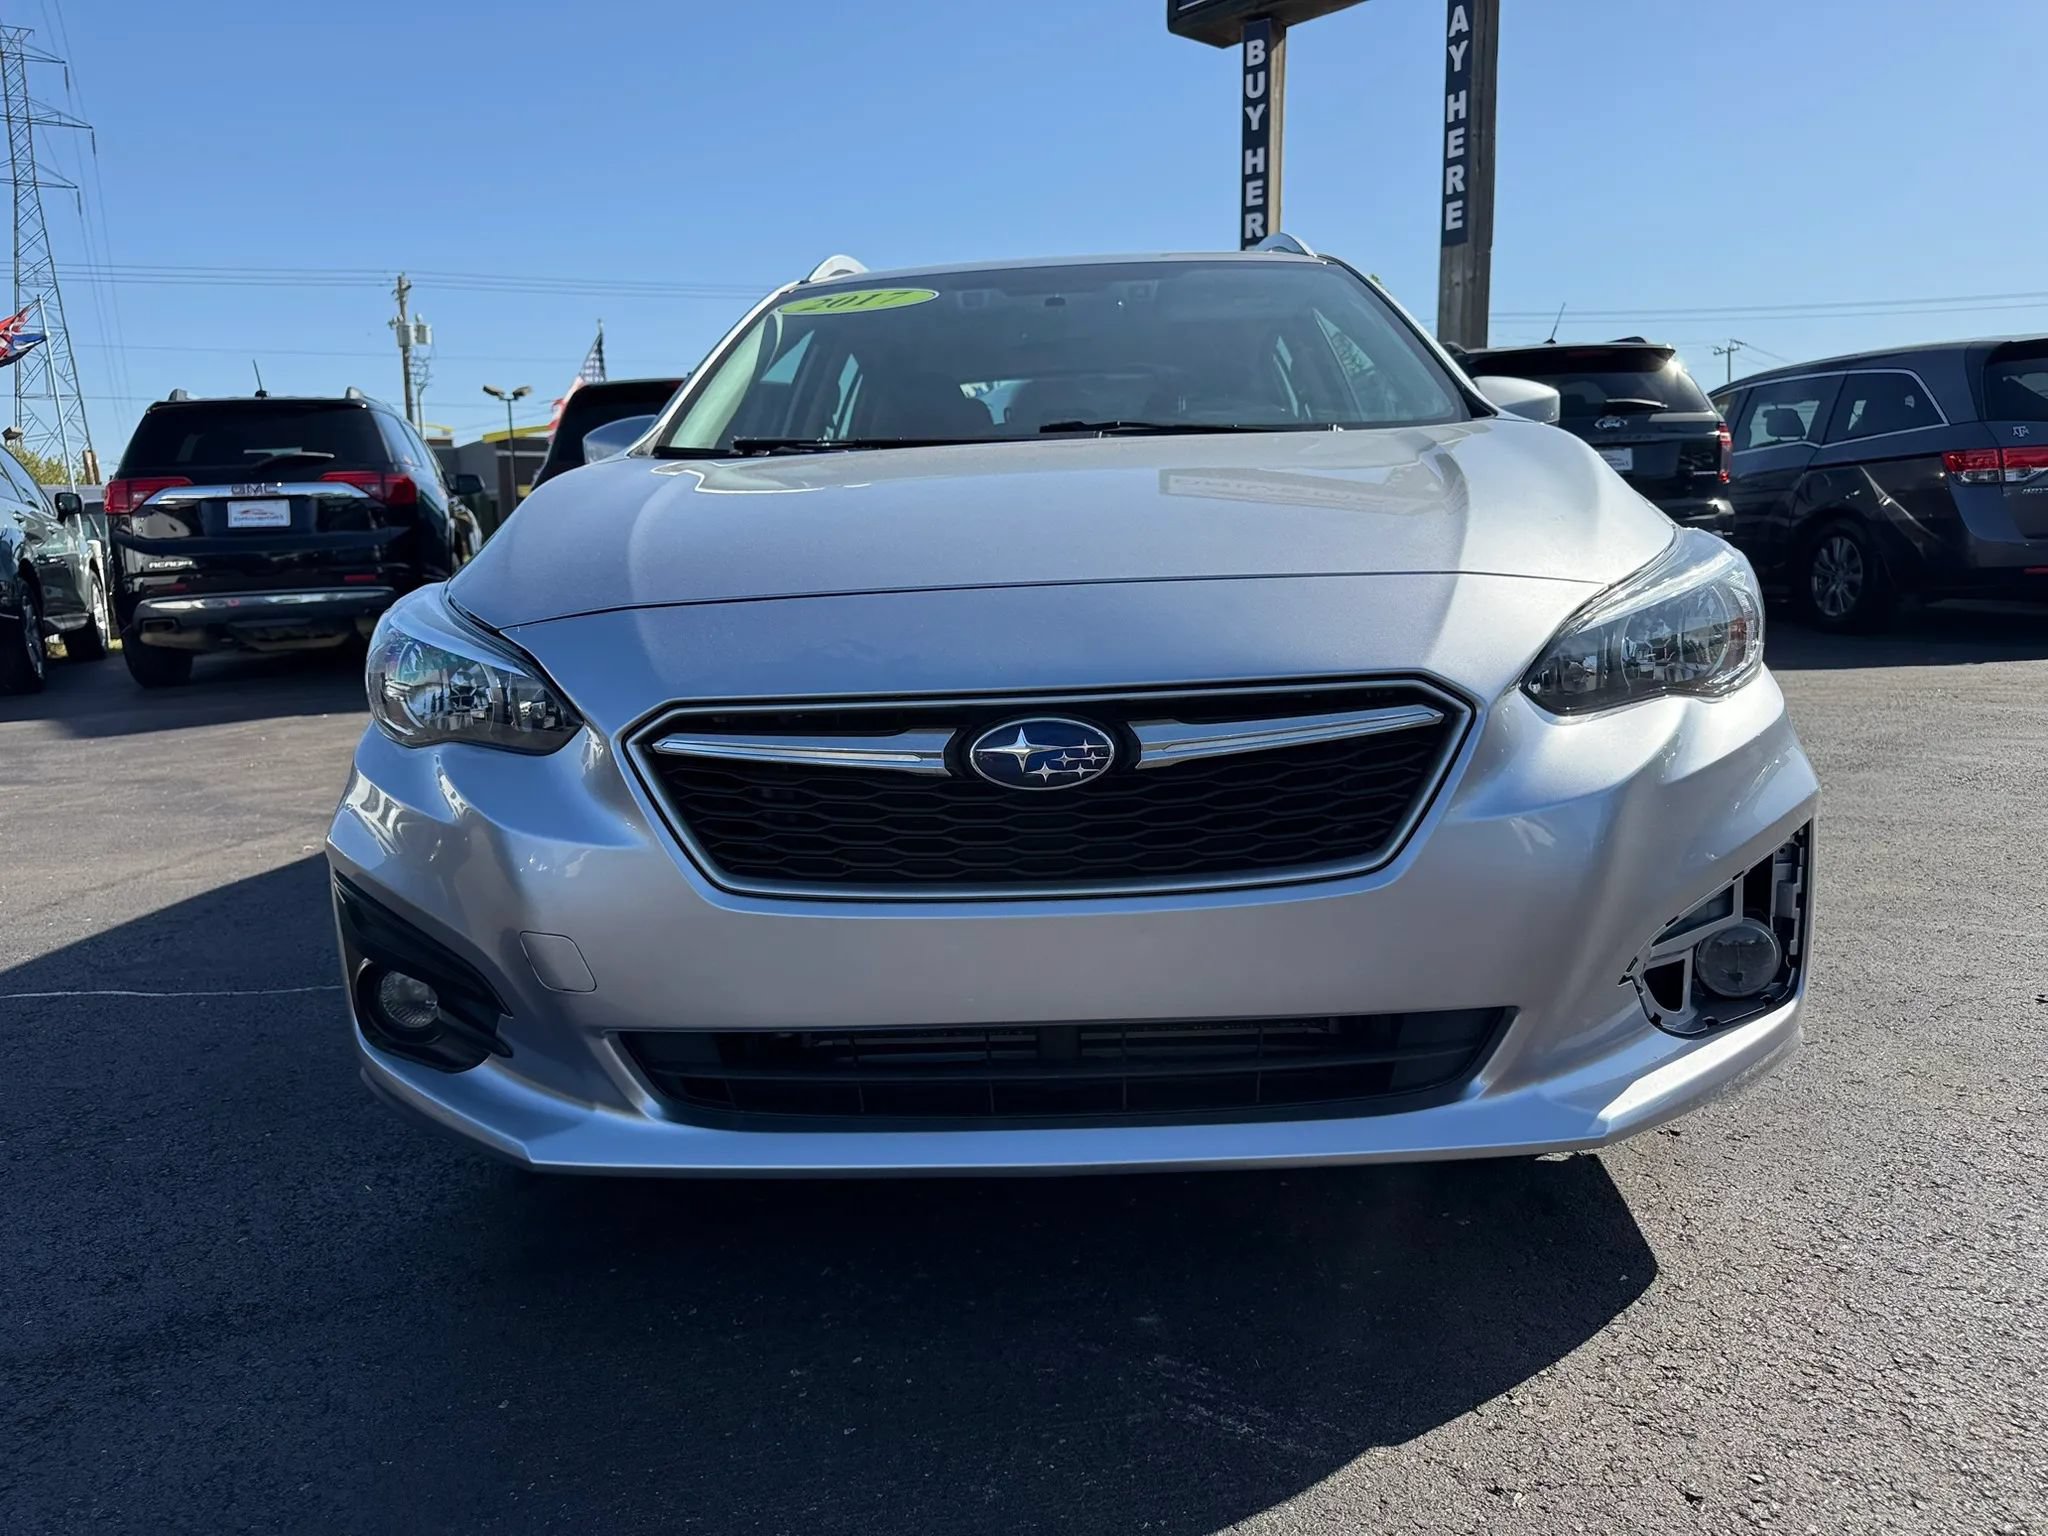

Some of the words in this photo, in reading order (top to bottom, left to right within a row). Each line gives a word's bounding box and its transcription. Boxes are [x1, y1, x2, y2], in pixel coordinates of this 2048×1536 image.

[1244, 39, 1266, 131] BUY
[1244, 147, 1266, 250] HER
[1445, 90, 1467, 231] HERE
[800, 291, 914, 312] 2017
[231, 482, 281, 496] GMC
